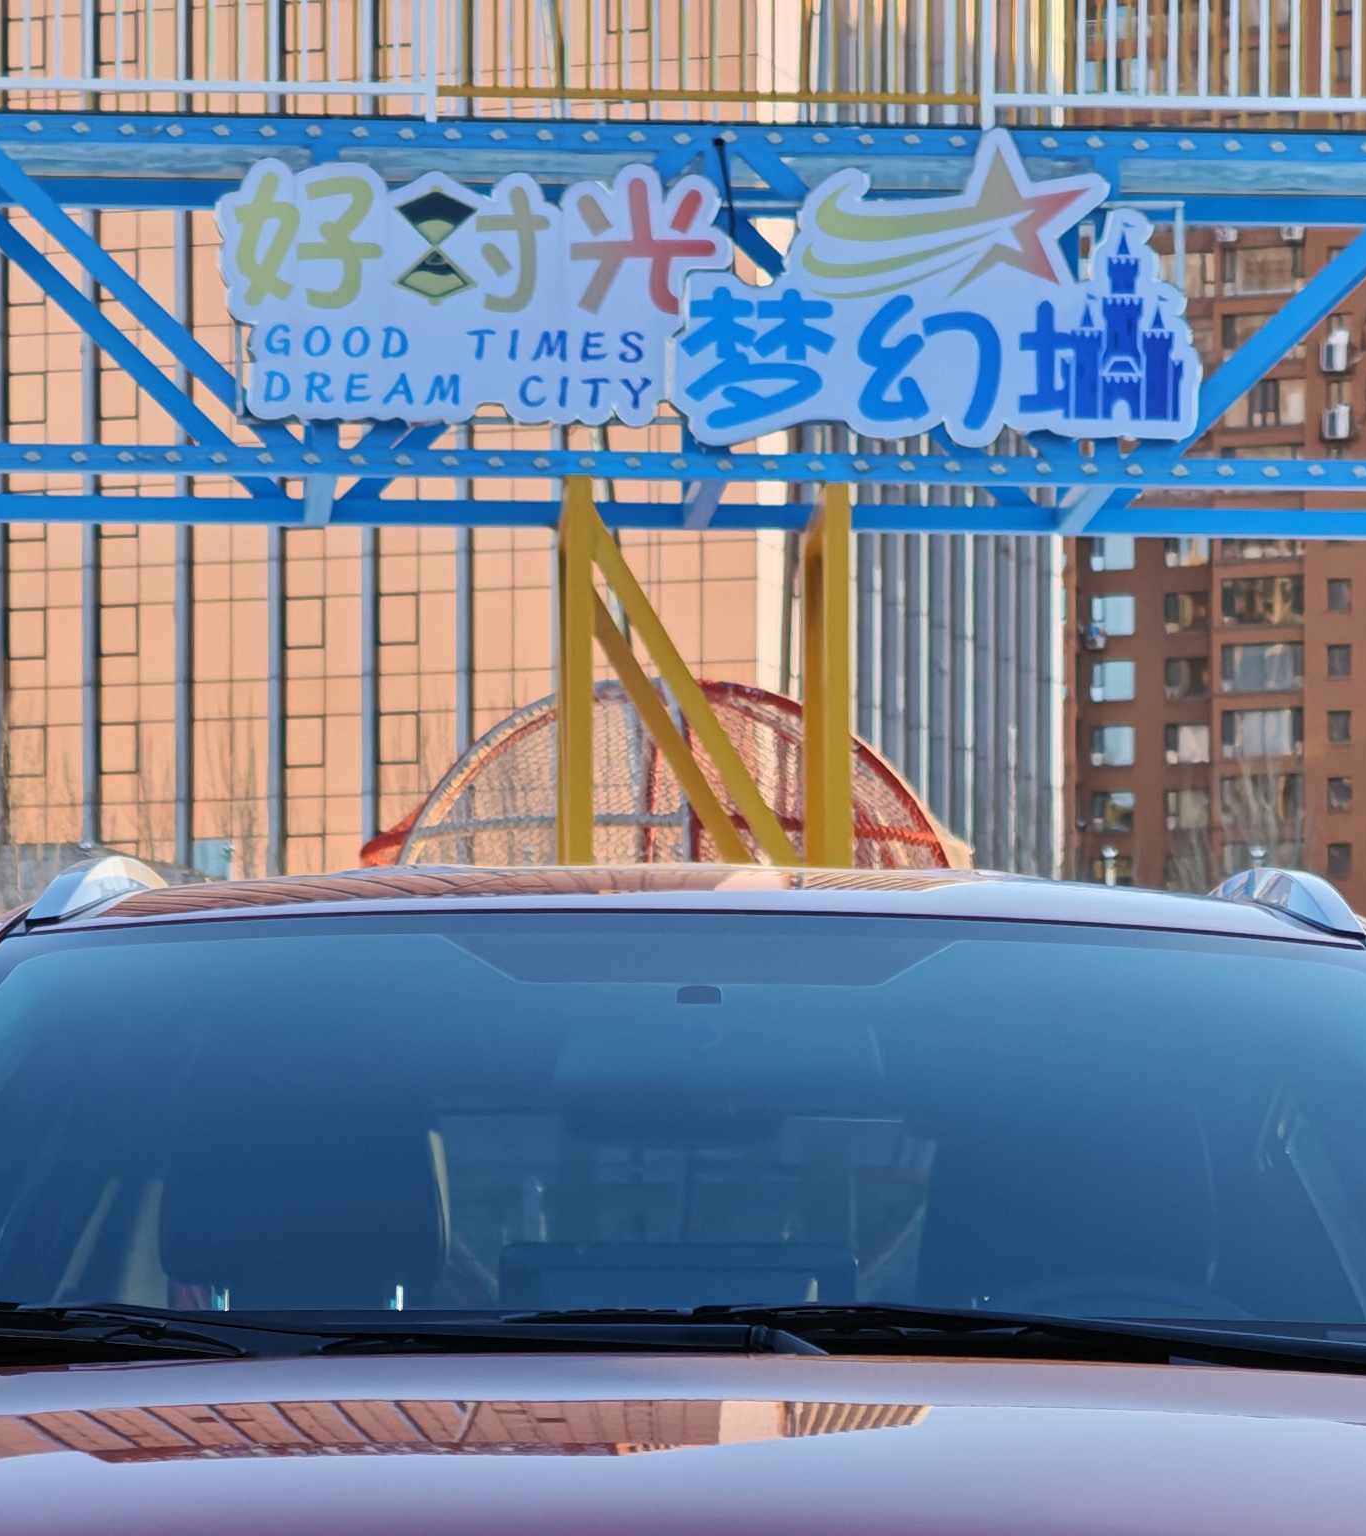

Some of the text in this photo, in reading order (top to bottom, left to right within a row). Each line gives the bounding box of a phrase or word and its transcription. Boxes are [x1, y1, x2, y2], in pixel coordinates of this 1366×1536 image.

[235, 171, 717, 315] 好时光
[264, 323, 646, 363] GOOD TIMES
[263, 371, 653, 410] DREAM CITY
